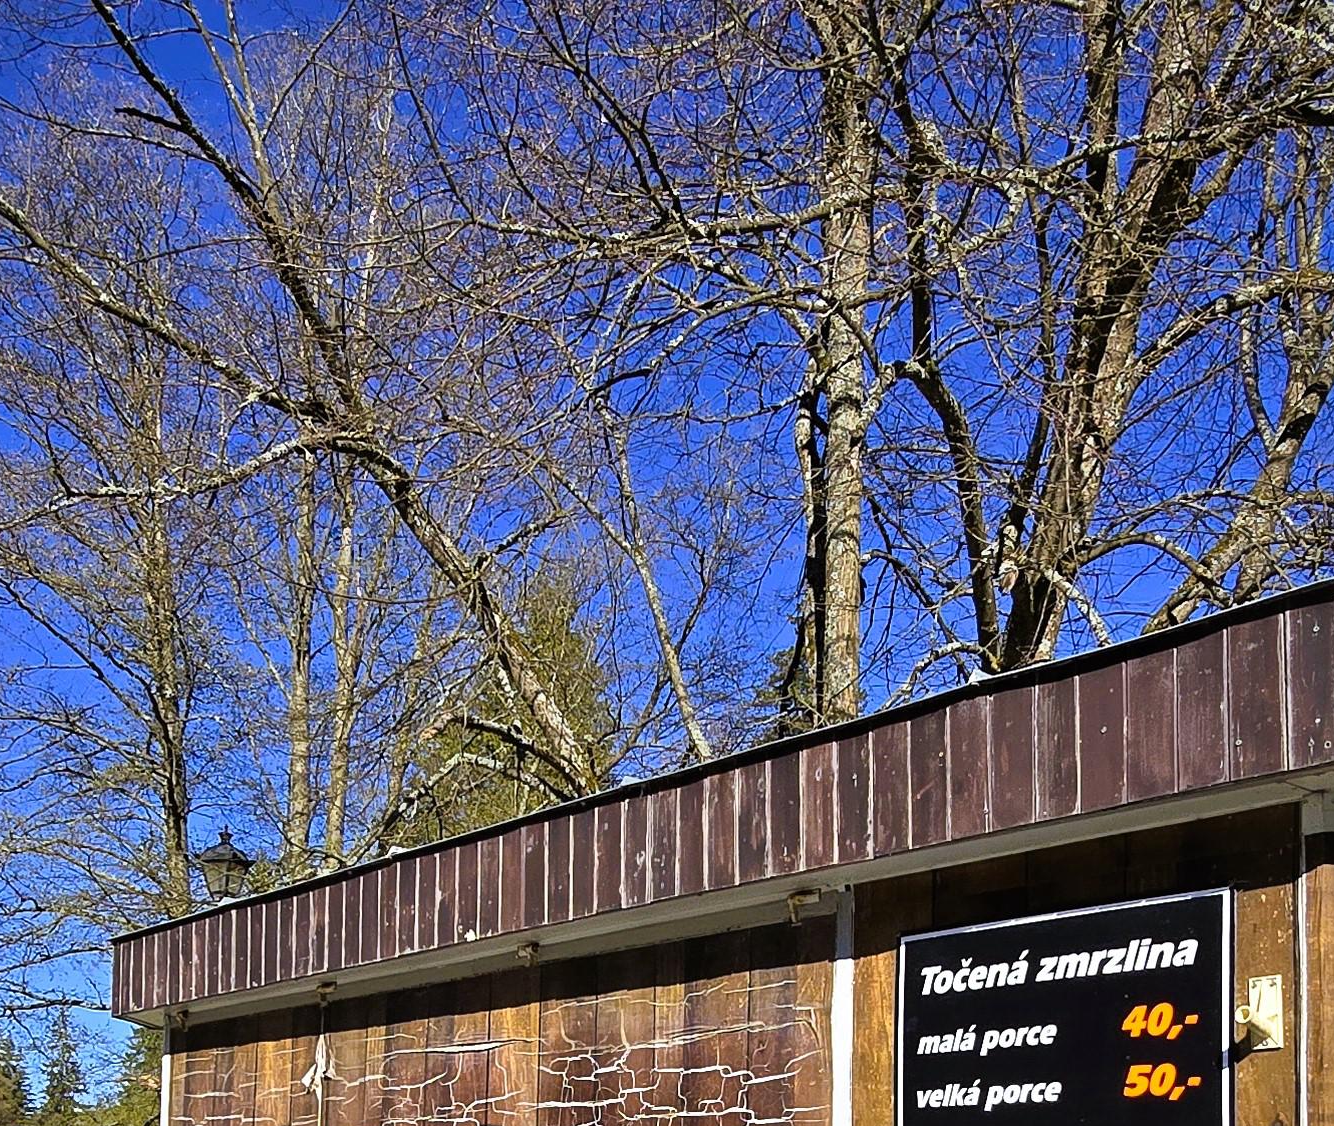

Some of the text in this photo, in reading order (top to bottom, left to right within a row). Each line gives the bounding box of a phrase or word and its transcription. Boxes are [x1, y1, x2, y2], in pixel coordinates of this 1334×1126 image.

[920, 937, 1200, 996] Točená zmrzlina
[916, 1001, 1200, 1057] malá porce 40,-
[915, 1062, 1202, 1112] velká porce 50,-
